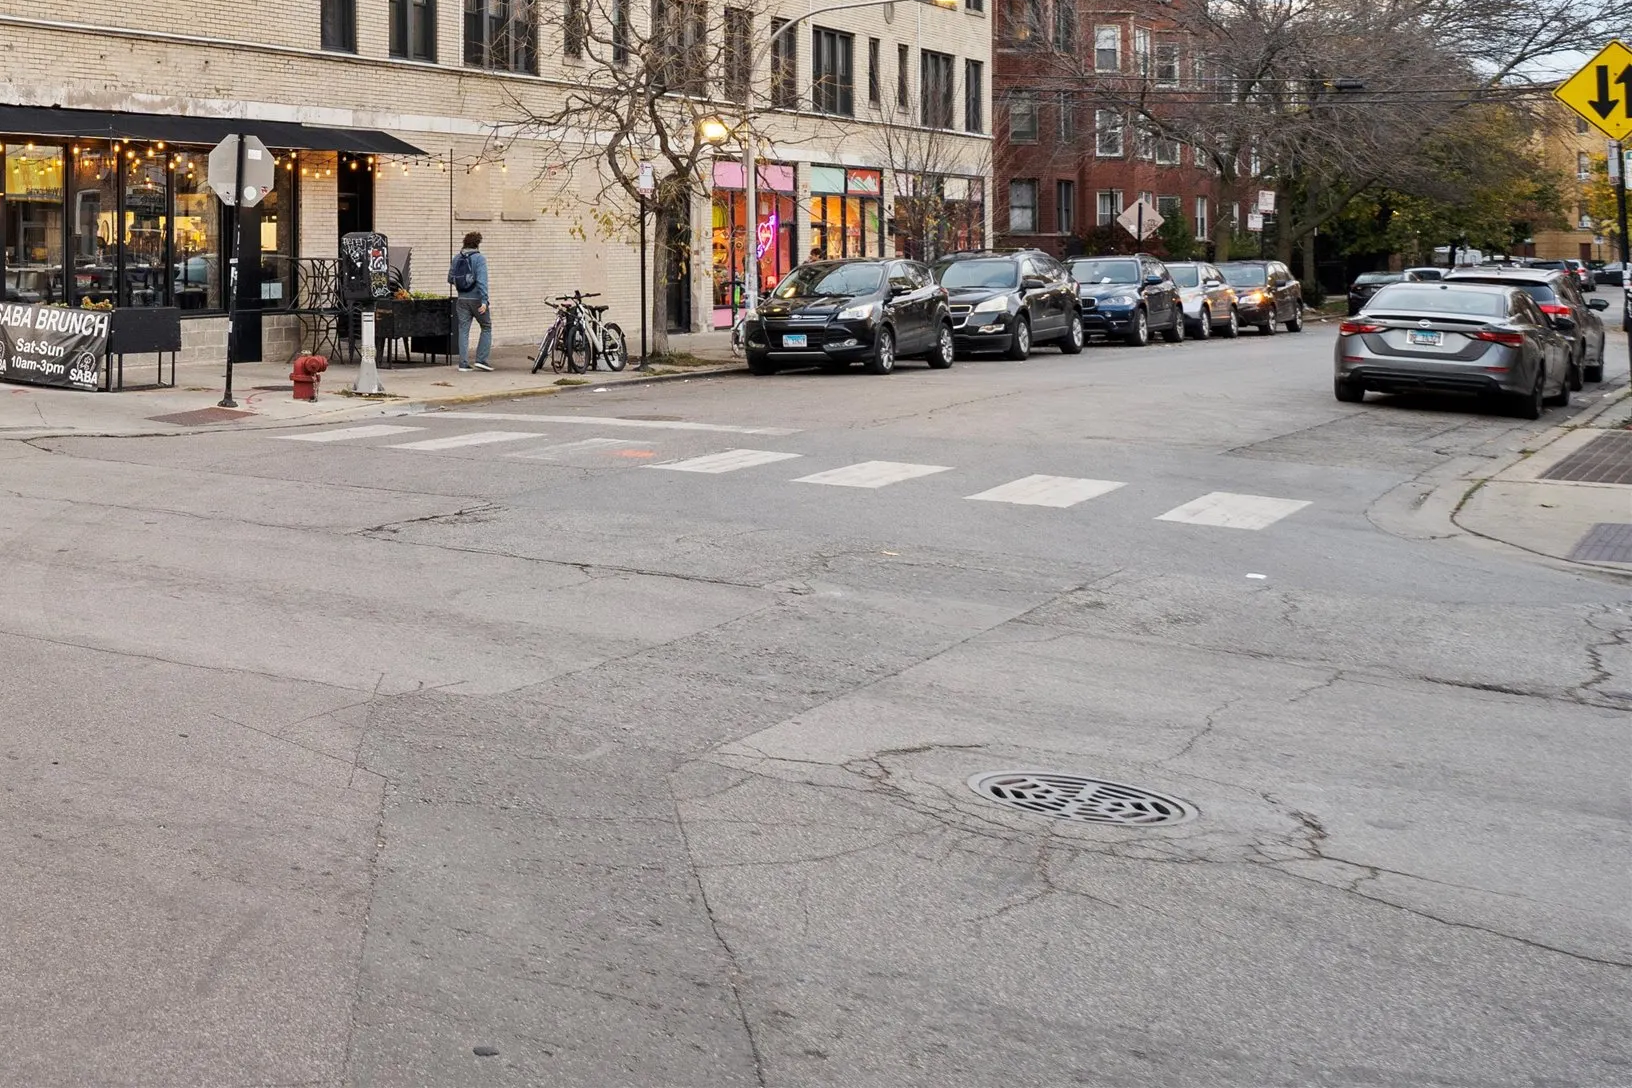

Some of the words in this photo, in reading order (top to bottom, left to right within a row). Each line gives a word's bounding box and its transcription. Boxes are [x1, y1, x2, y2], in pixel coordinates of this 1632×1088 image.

[35, 308, 108, 338] BRUNCH
[15, 338, 65, 358] Sat-Sun
[11, 355, 65, 376] 10am-3pm
[69, 368, 98, 385] SABA
